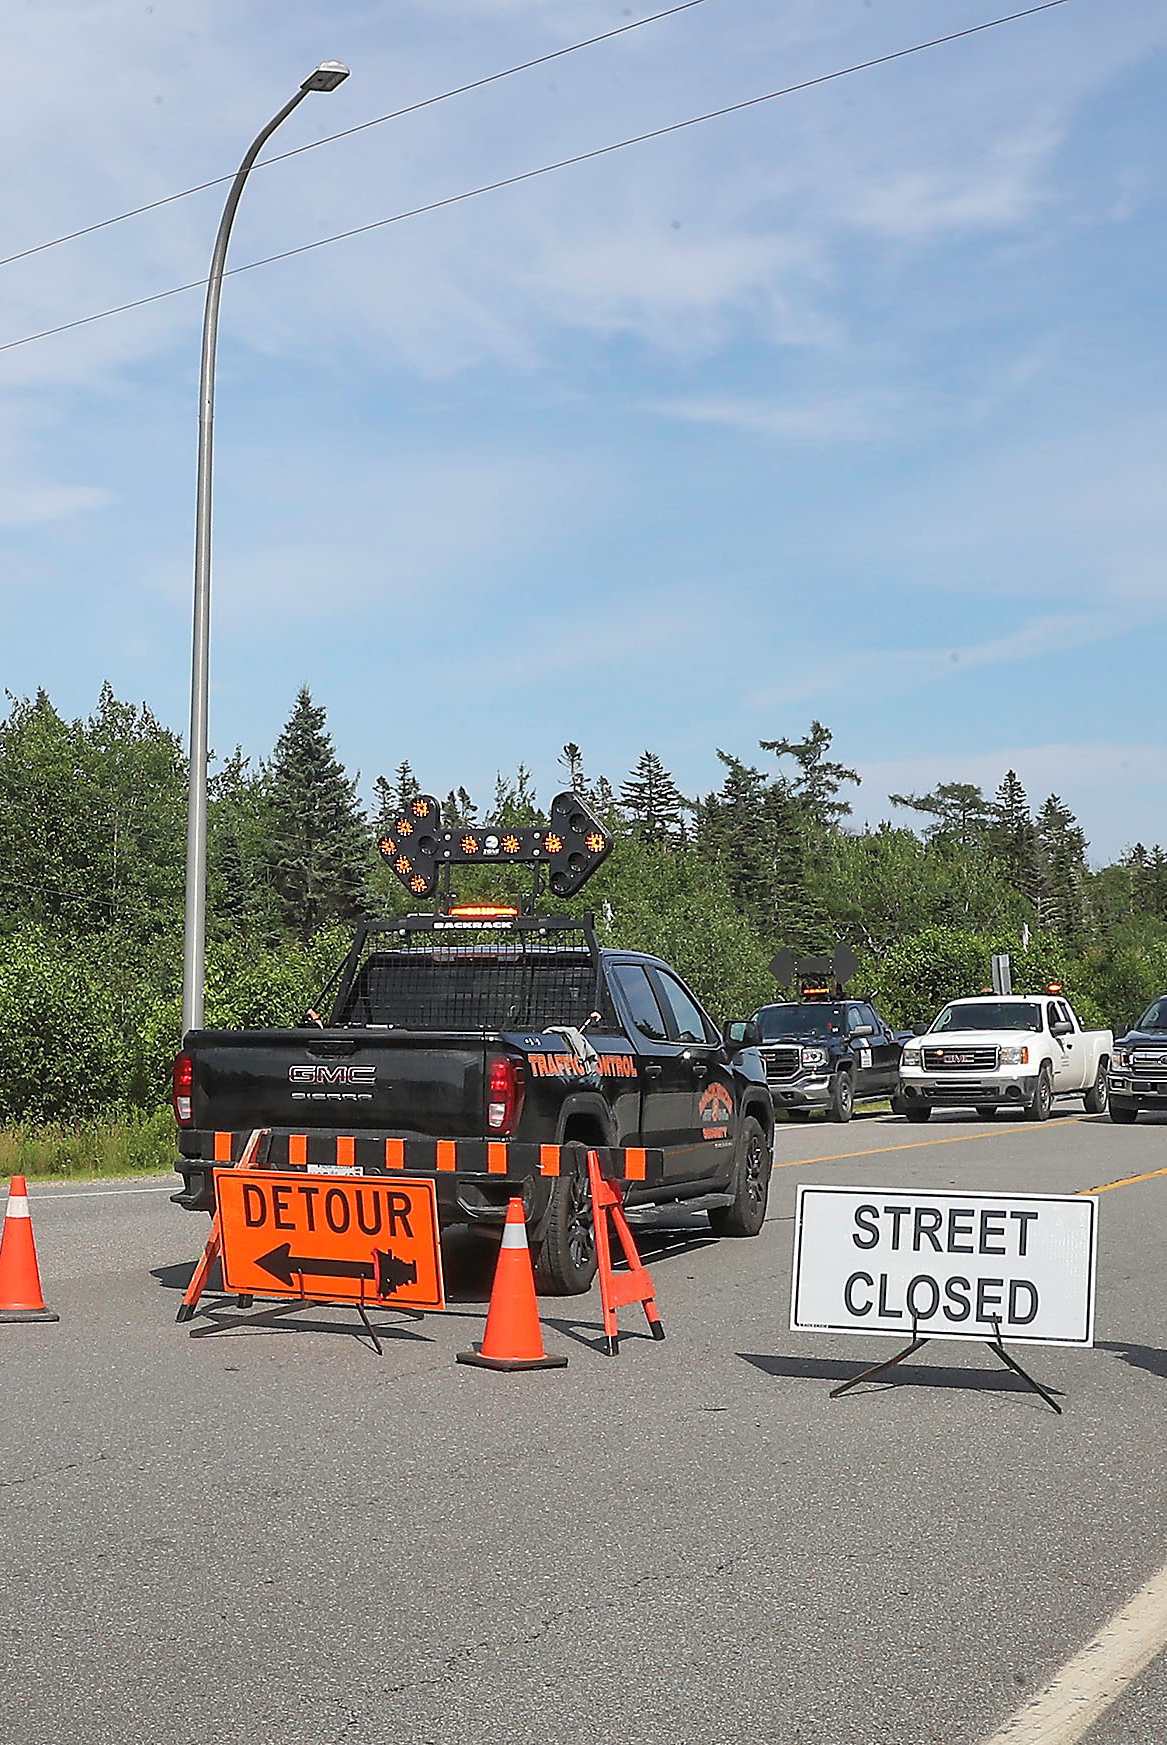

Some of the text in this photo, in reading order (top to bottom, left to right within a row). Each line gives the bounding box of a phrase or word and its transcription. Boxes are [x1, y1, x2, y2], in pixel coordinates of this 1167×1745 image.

[433, 921, 513, 929] BACKRACK
[289, 1065, 376, 1084] GMC
[528, 1053, 637, 1077] TRAFFIC ONTROL
[242, 1183, 414, 1238] DETOUR
[852, 1204, 1038, 1256] STREET
[844, 1271, 1039, 1325] CLOSED
